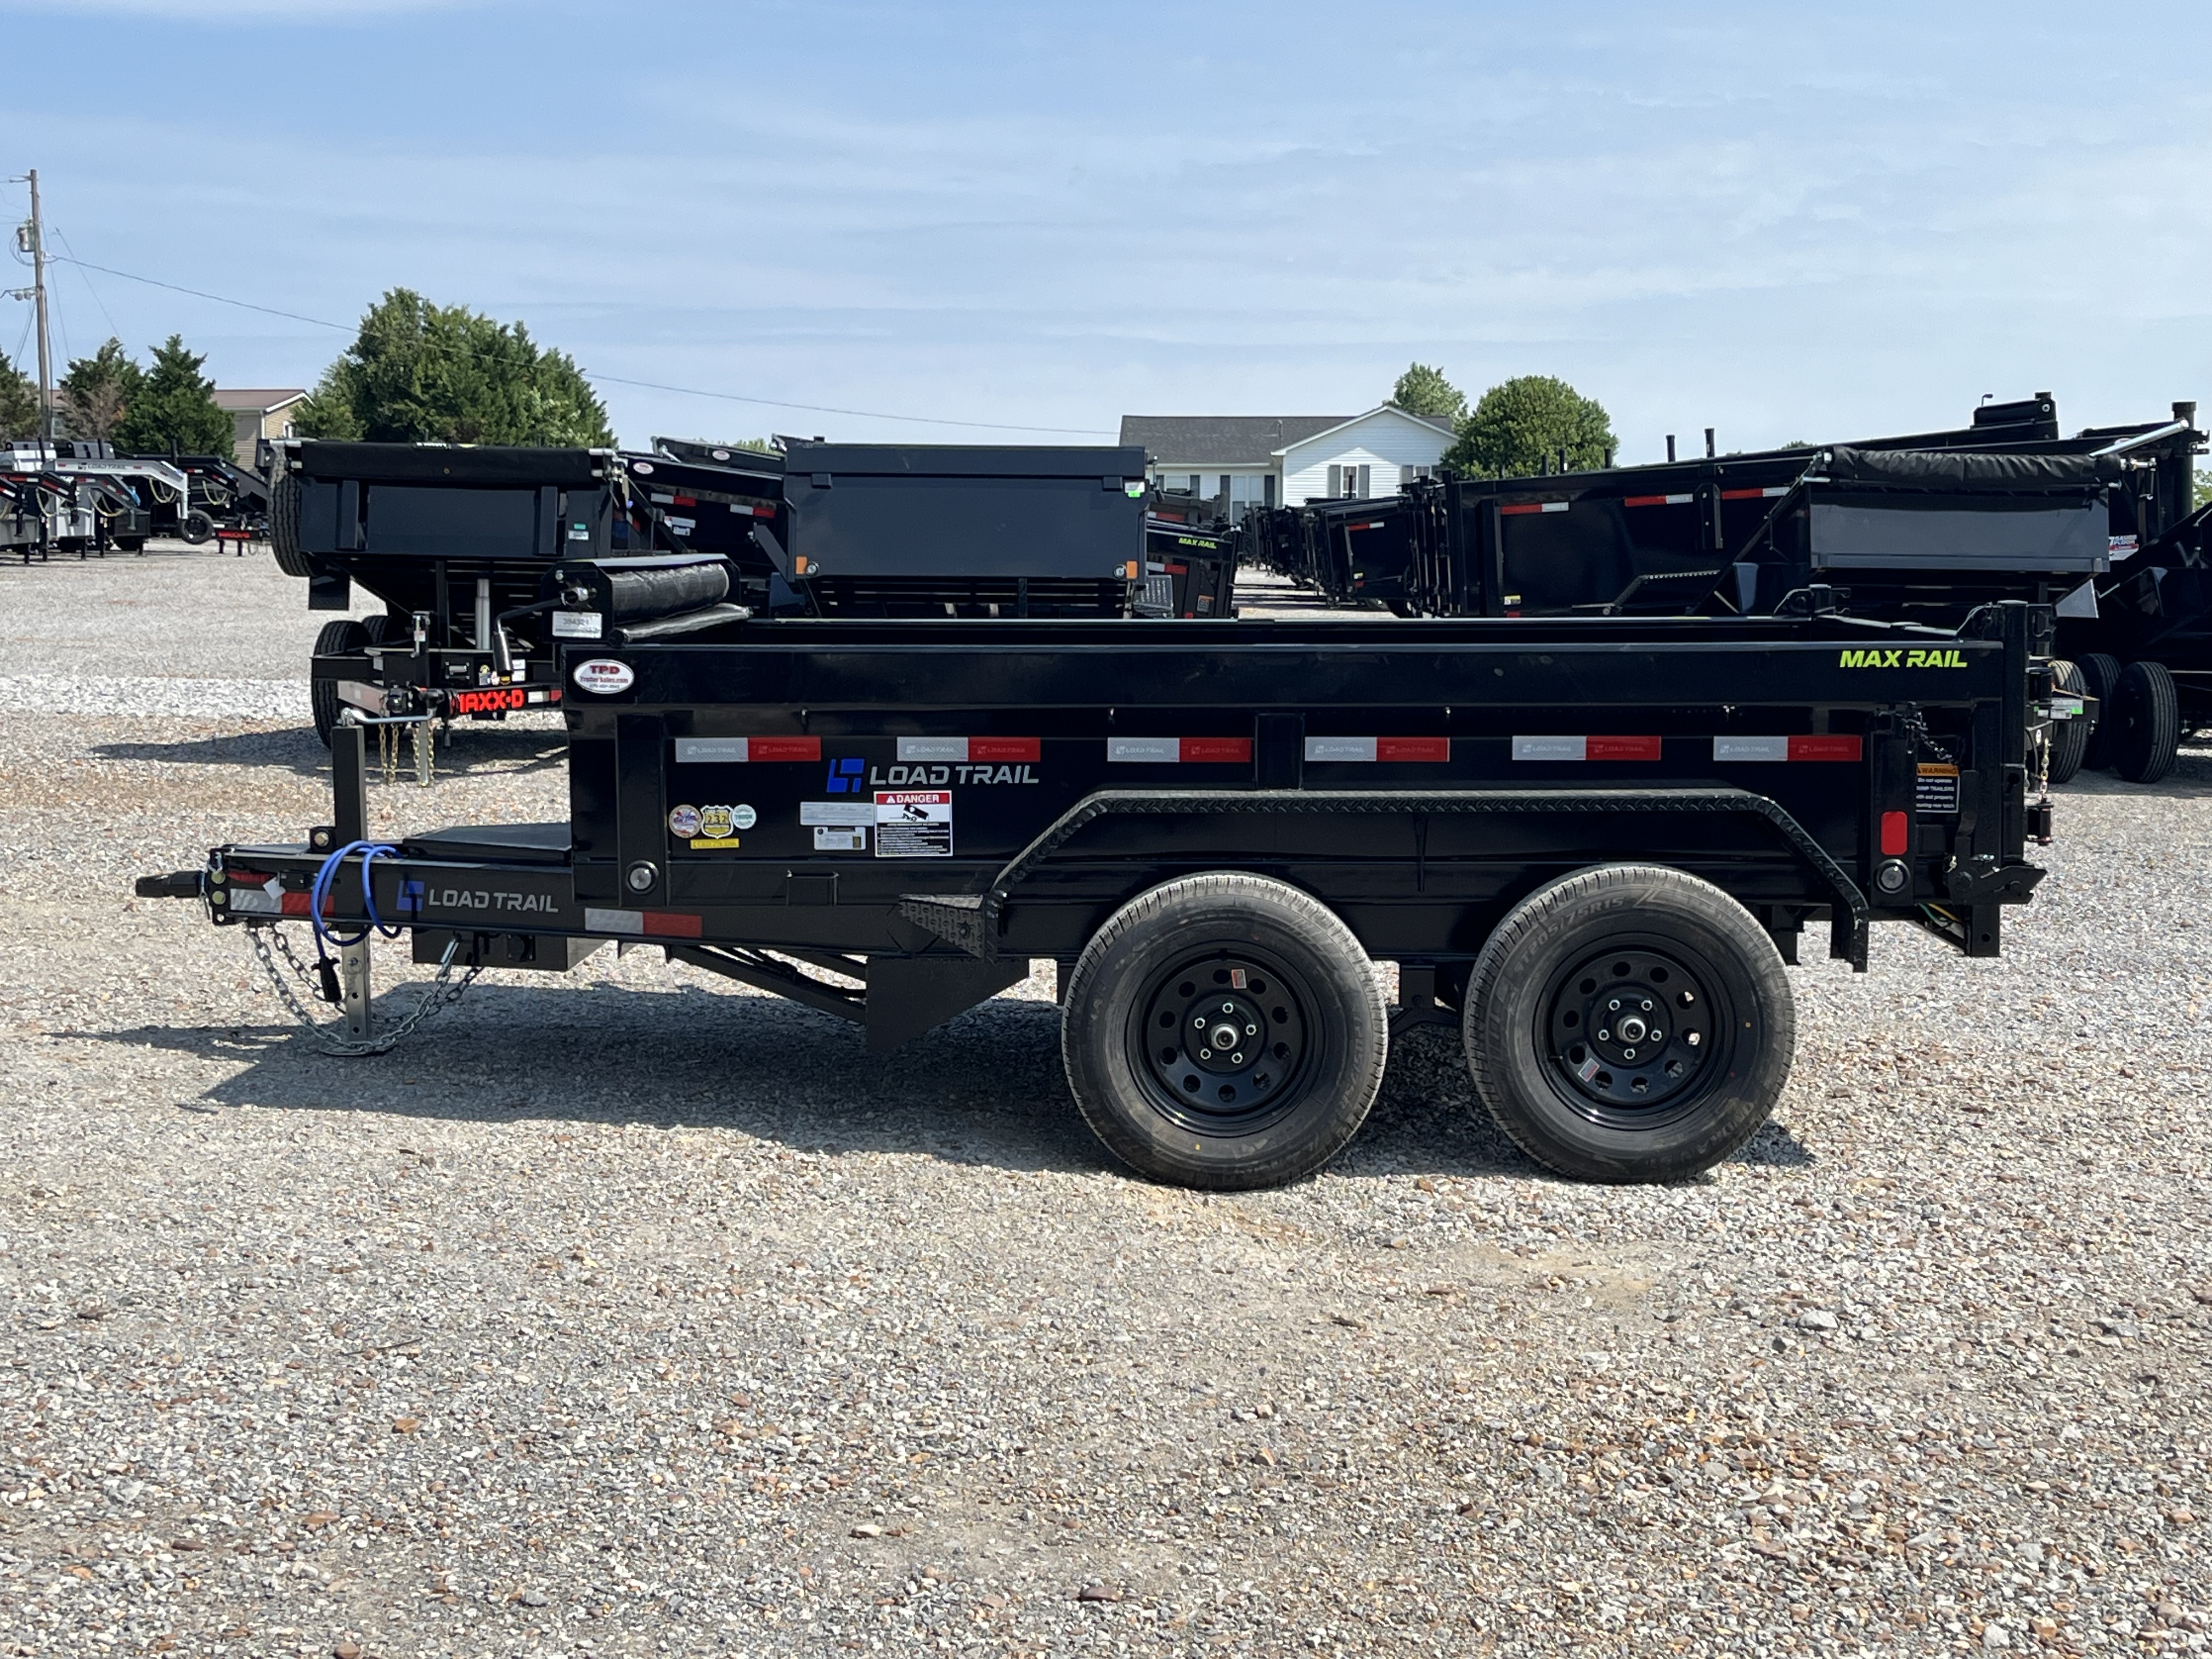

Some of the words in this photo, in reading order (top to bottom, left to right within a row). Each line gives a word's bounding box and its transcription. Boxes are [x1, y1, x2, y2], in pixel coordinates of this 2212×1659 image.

[1179, 537, 1198, 546] MAX
[1839, 650, 1903, 668] MAX
[1906, 650, 1968, 668] RAIL
[589, 665, 620, 675] TPD
[870, 766, 950, 785] LOAD
[955, 765, 1039, 785] TRAIL
[896, 794, 939, 803] DANGER
[428, 889, 489, 908] LOAD
[494, 892, 558, 913] TRAIL
[1514, 897, 1625, 973] ST205/75R15
